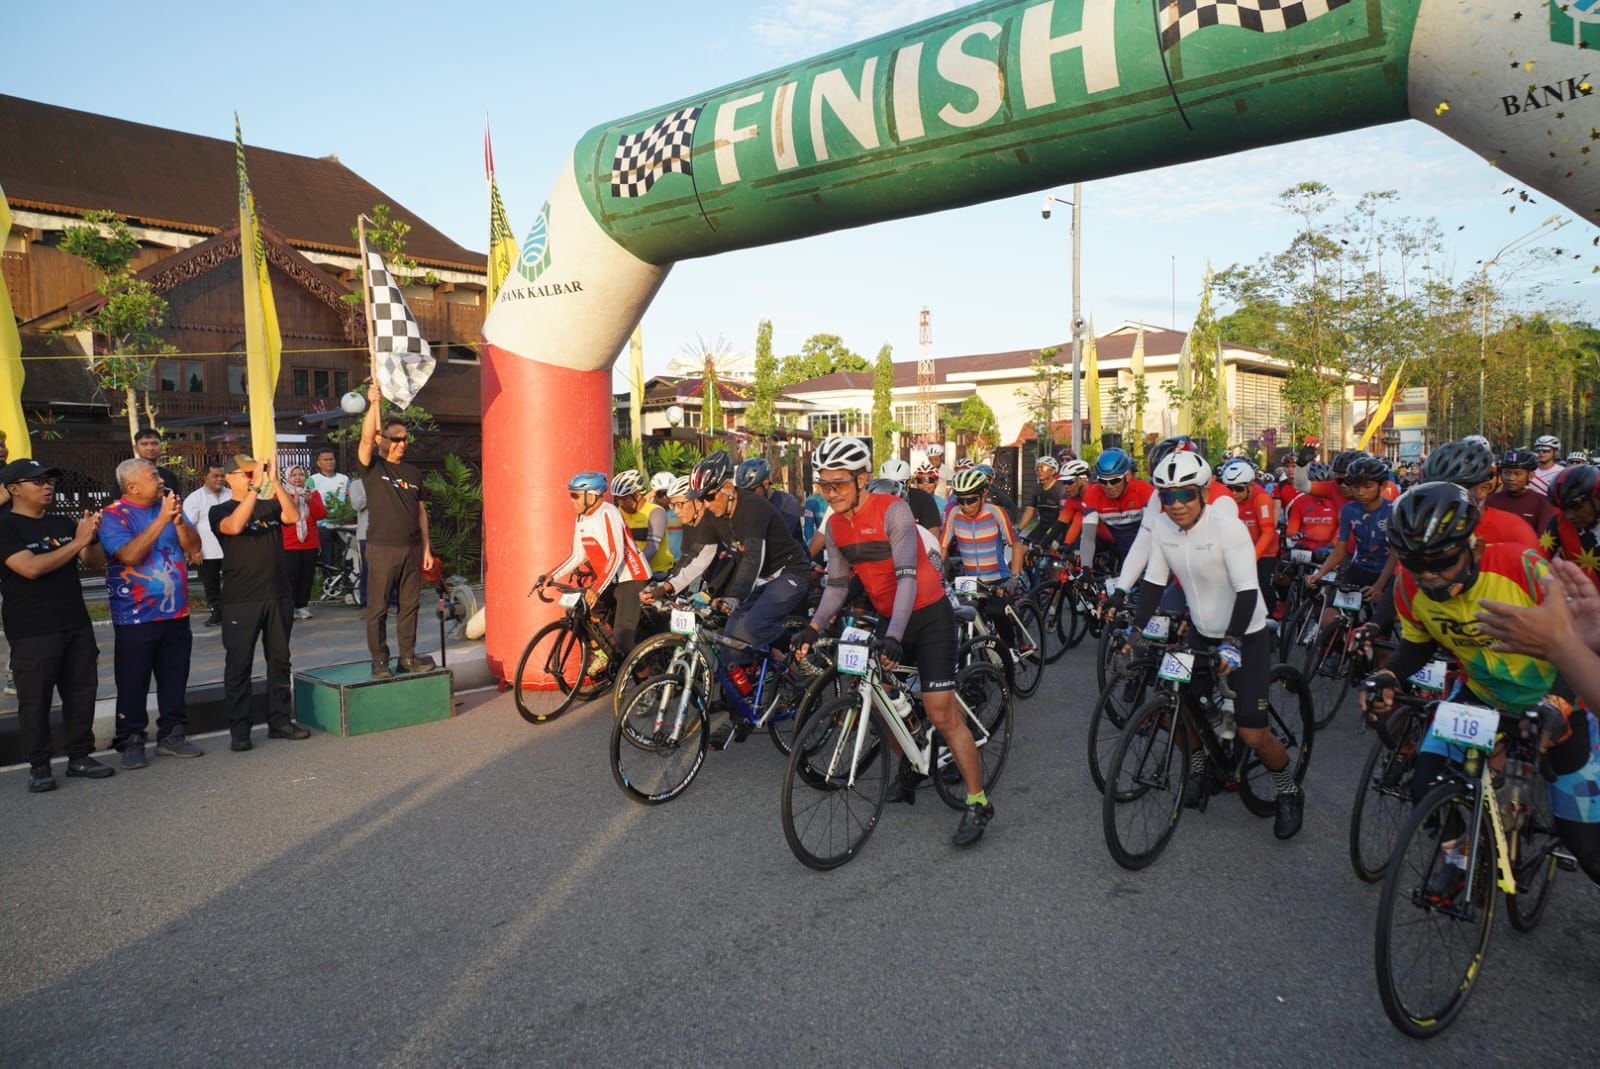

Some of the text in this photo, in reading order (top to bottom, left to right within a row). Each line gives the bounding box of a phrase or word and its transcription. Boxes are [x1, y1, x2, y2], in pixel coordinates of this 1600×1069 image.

[713, 0, 1120, 186] FINISH
[1500, 72, 1594, 117] BANK
[501, 280, 584, 303] BANK KALBAR
[844, 653, 859, 666] 112
[1453, 716, 1479, 738] 118
